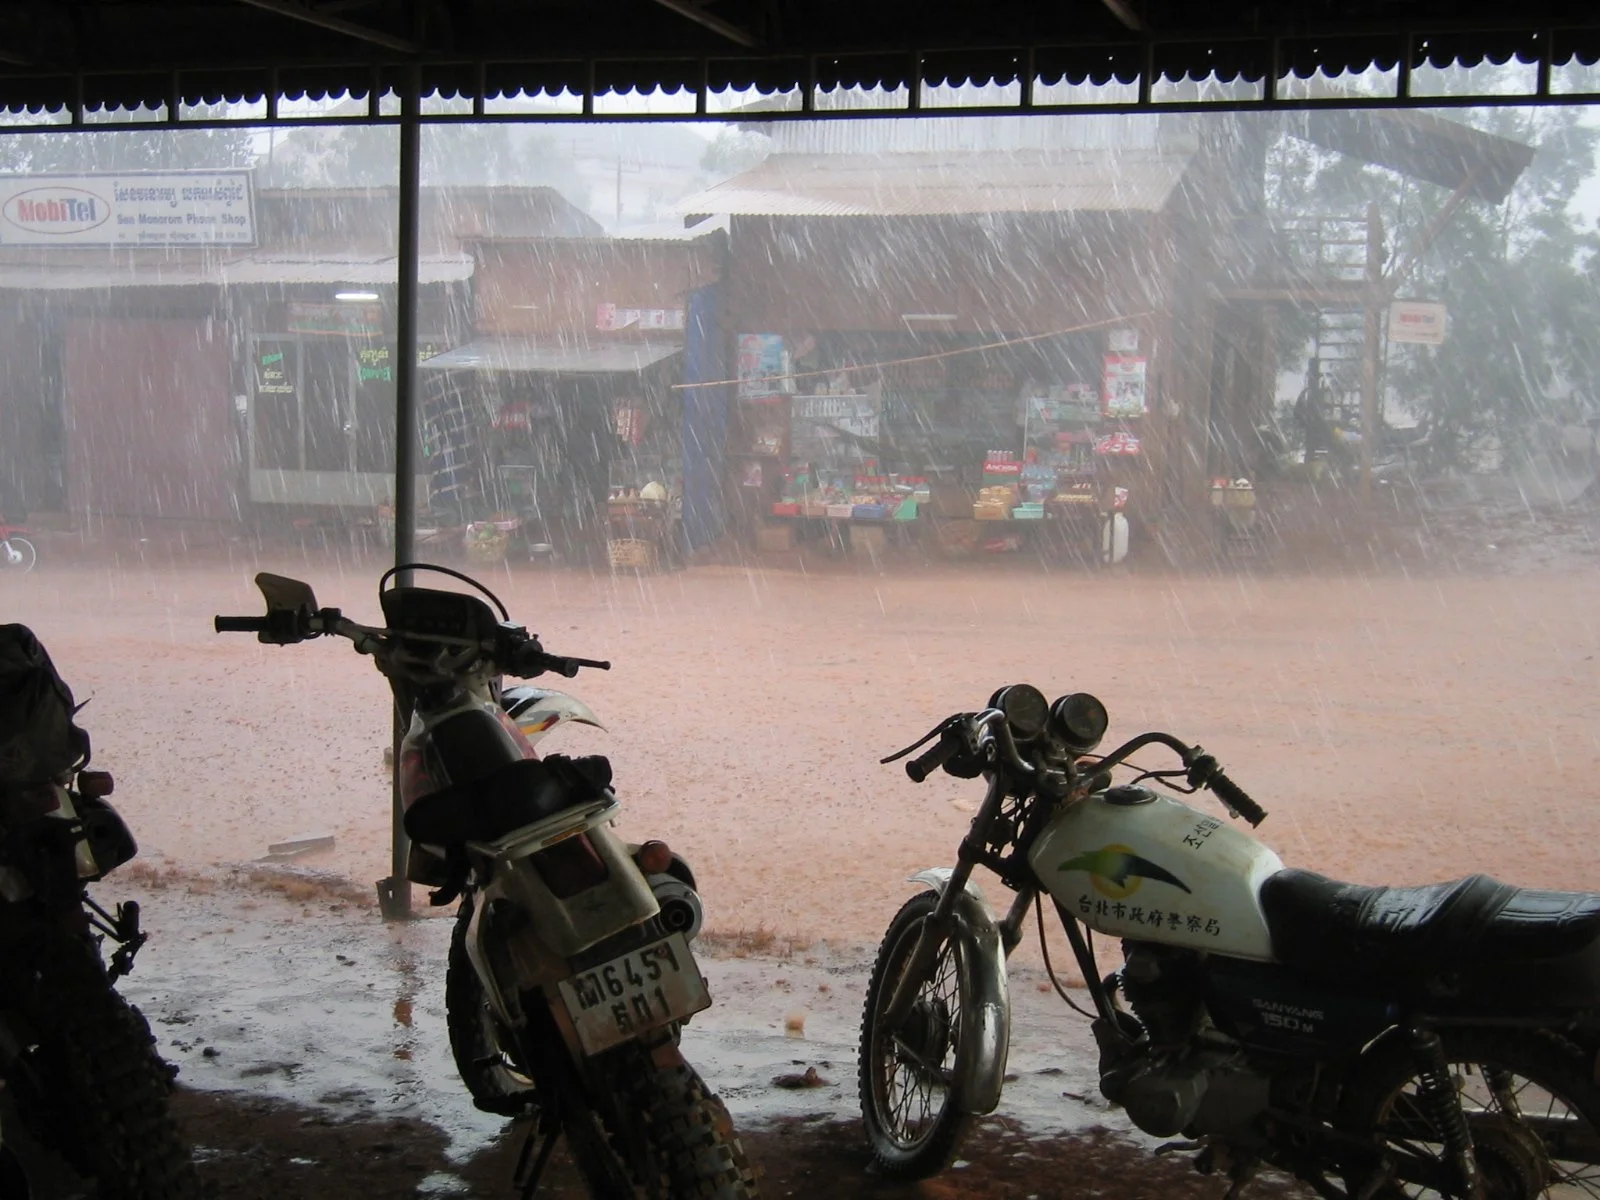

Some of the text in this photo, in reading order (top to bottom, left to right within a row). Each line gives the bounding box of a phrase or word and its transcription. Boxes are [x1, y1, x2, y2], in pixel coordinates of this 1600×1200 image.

[17, 198, 97, 222] MobiTel
[186, 213, 217, 225] Phone
[222, 213, 246, 228] Shop
[1182, 816, 1224, 850] 조선일
[1078, 894, 1221, 937] 台北市政府警察局
[1252, 999, 1324, 1020] SANYANG
